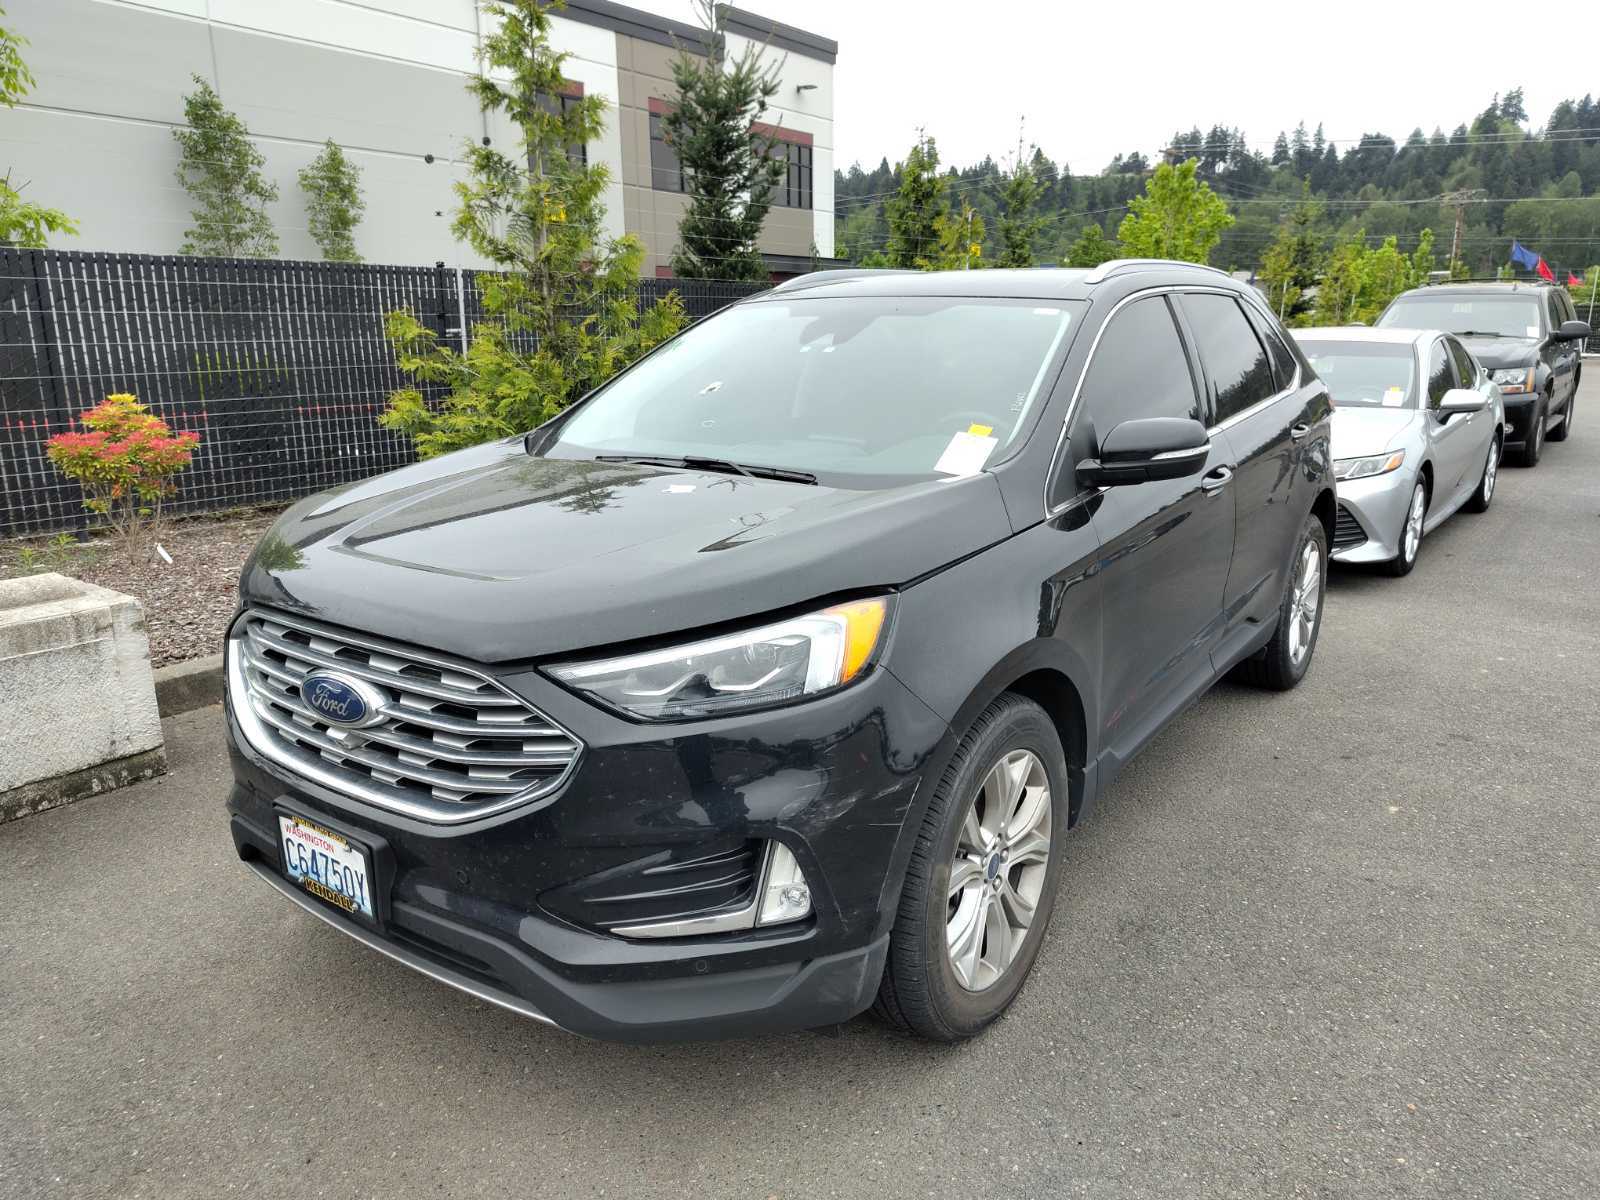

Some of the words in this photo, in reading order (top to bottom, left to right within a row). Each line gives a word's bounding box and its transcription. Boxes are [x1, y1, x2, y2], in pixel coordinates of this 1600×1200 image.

[312, 683, 350, 716] Ford
[285, 823, 335, 854] WASHINGTON
[286, 838, 365, 906] C64750Y
